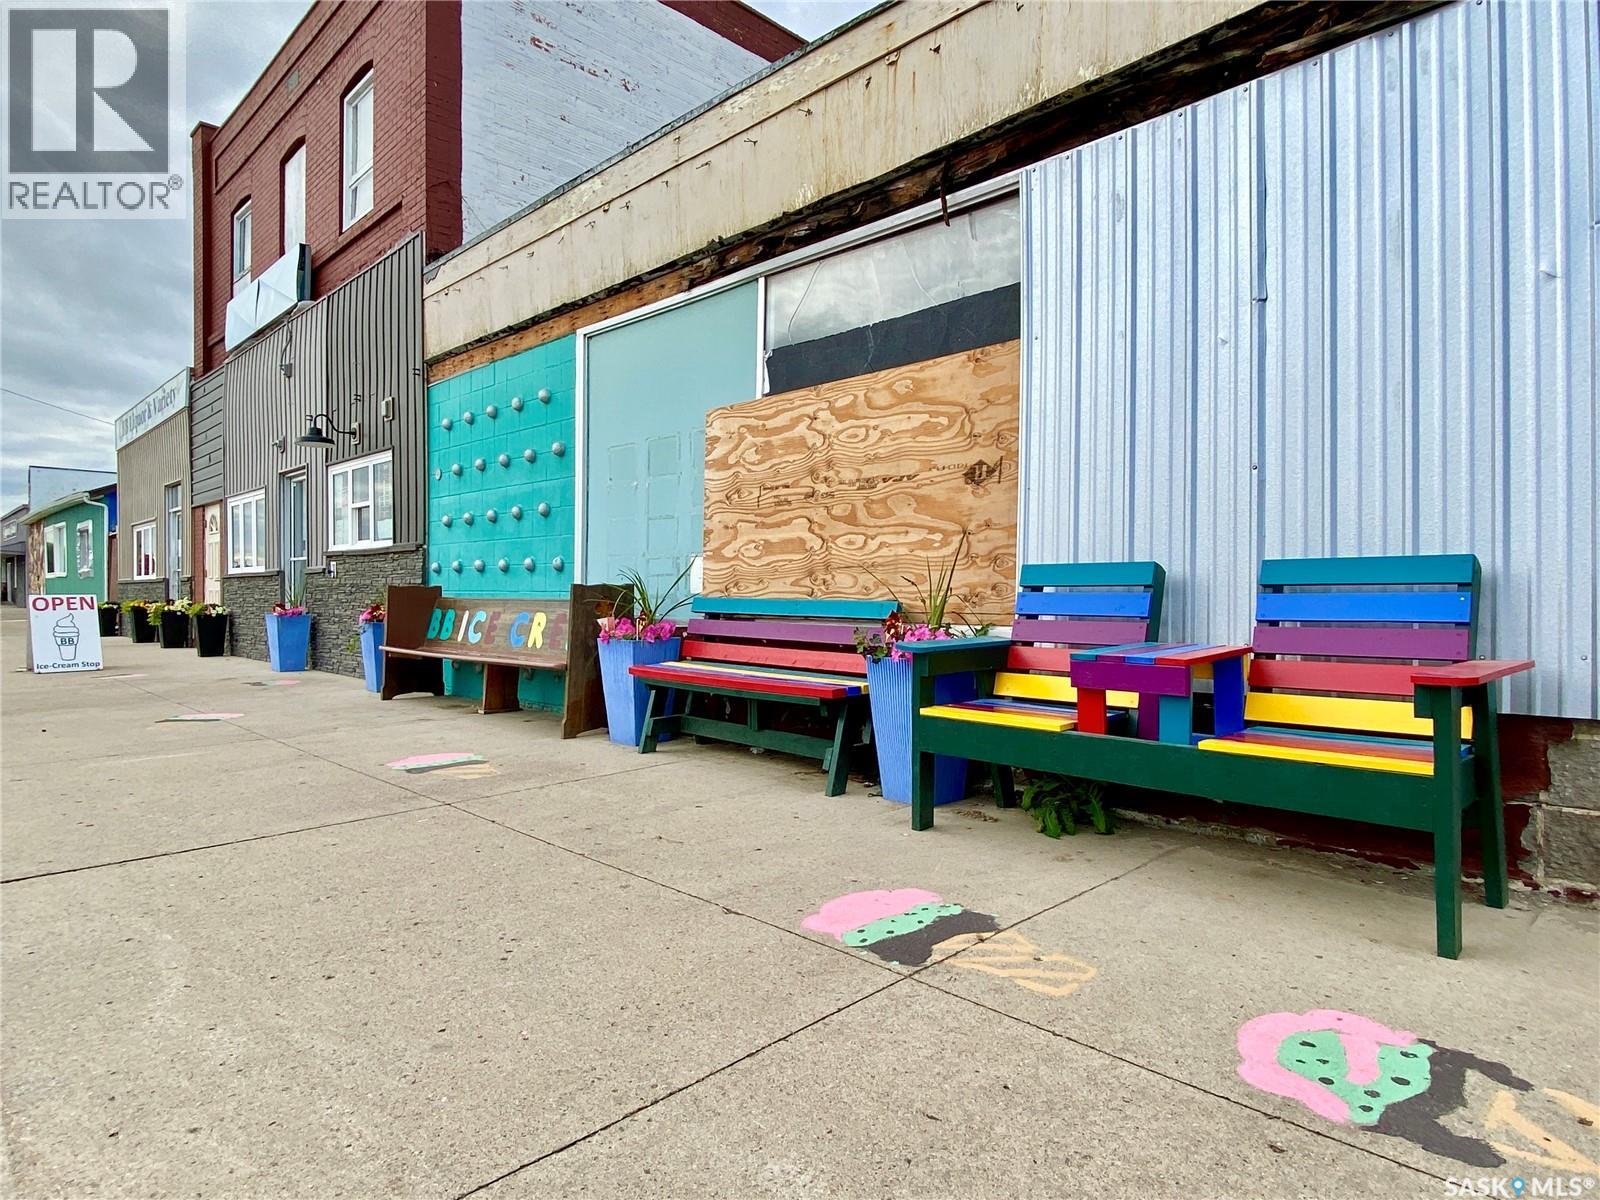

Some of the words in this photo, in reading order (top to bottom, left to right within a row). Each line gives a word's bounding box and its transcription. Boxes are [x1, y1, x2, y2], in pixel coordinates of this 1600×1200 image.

[32, 596, 95, 611] OPEN
[426, 608, 456, 640] BB
[457, 609, 502, 645] ICE
[508, 611, 569, 651] CRE
[60, 637, 75, 645] BB
